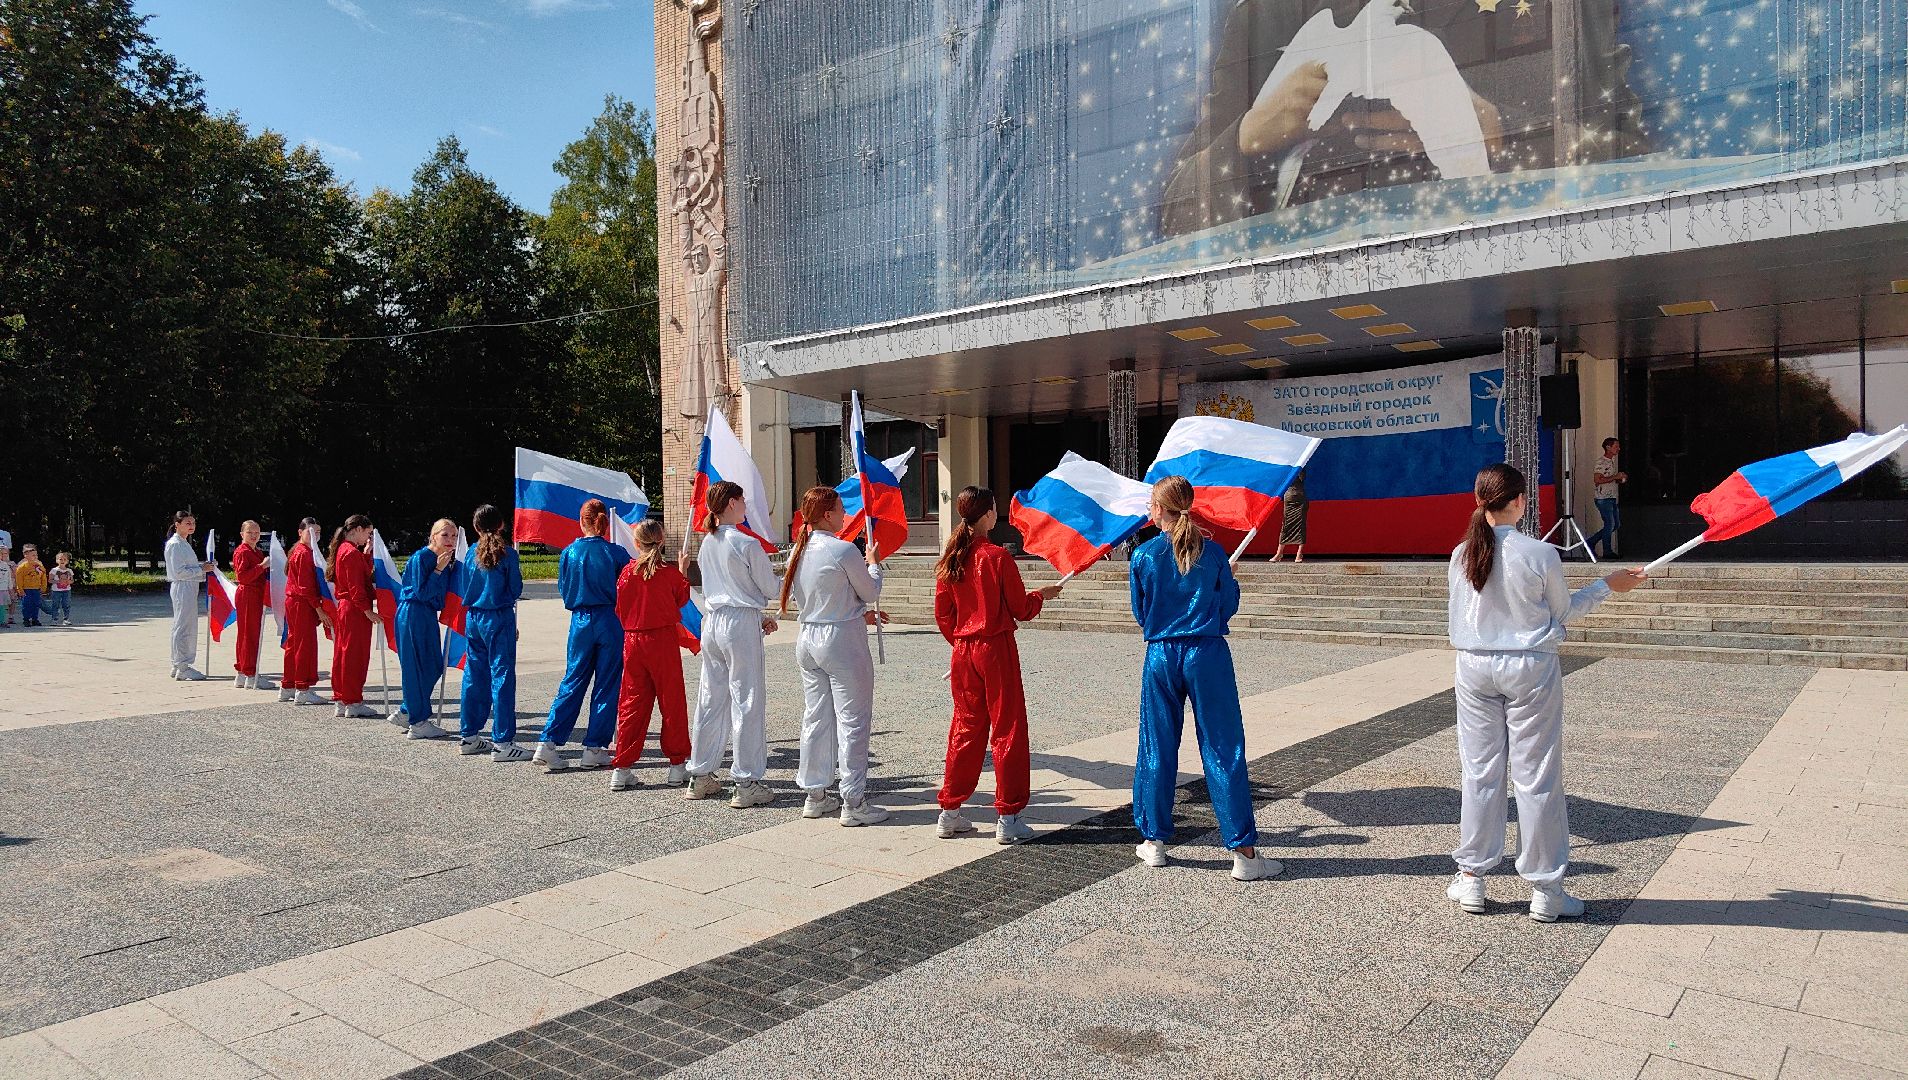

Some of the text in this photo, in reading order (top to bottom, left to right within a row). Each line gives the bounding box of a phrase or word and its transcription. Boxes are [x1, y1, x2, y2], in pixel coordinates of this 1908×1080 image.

[1273, 374, 1443, 399] ЗАТО городской округ
[1287, 394, 1432, 416] Звёздный городок
[1281, 411, 1440, 433] Московской области
